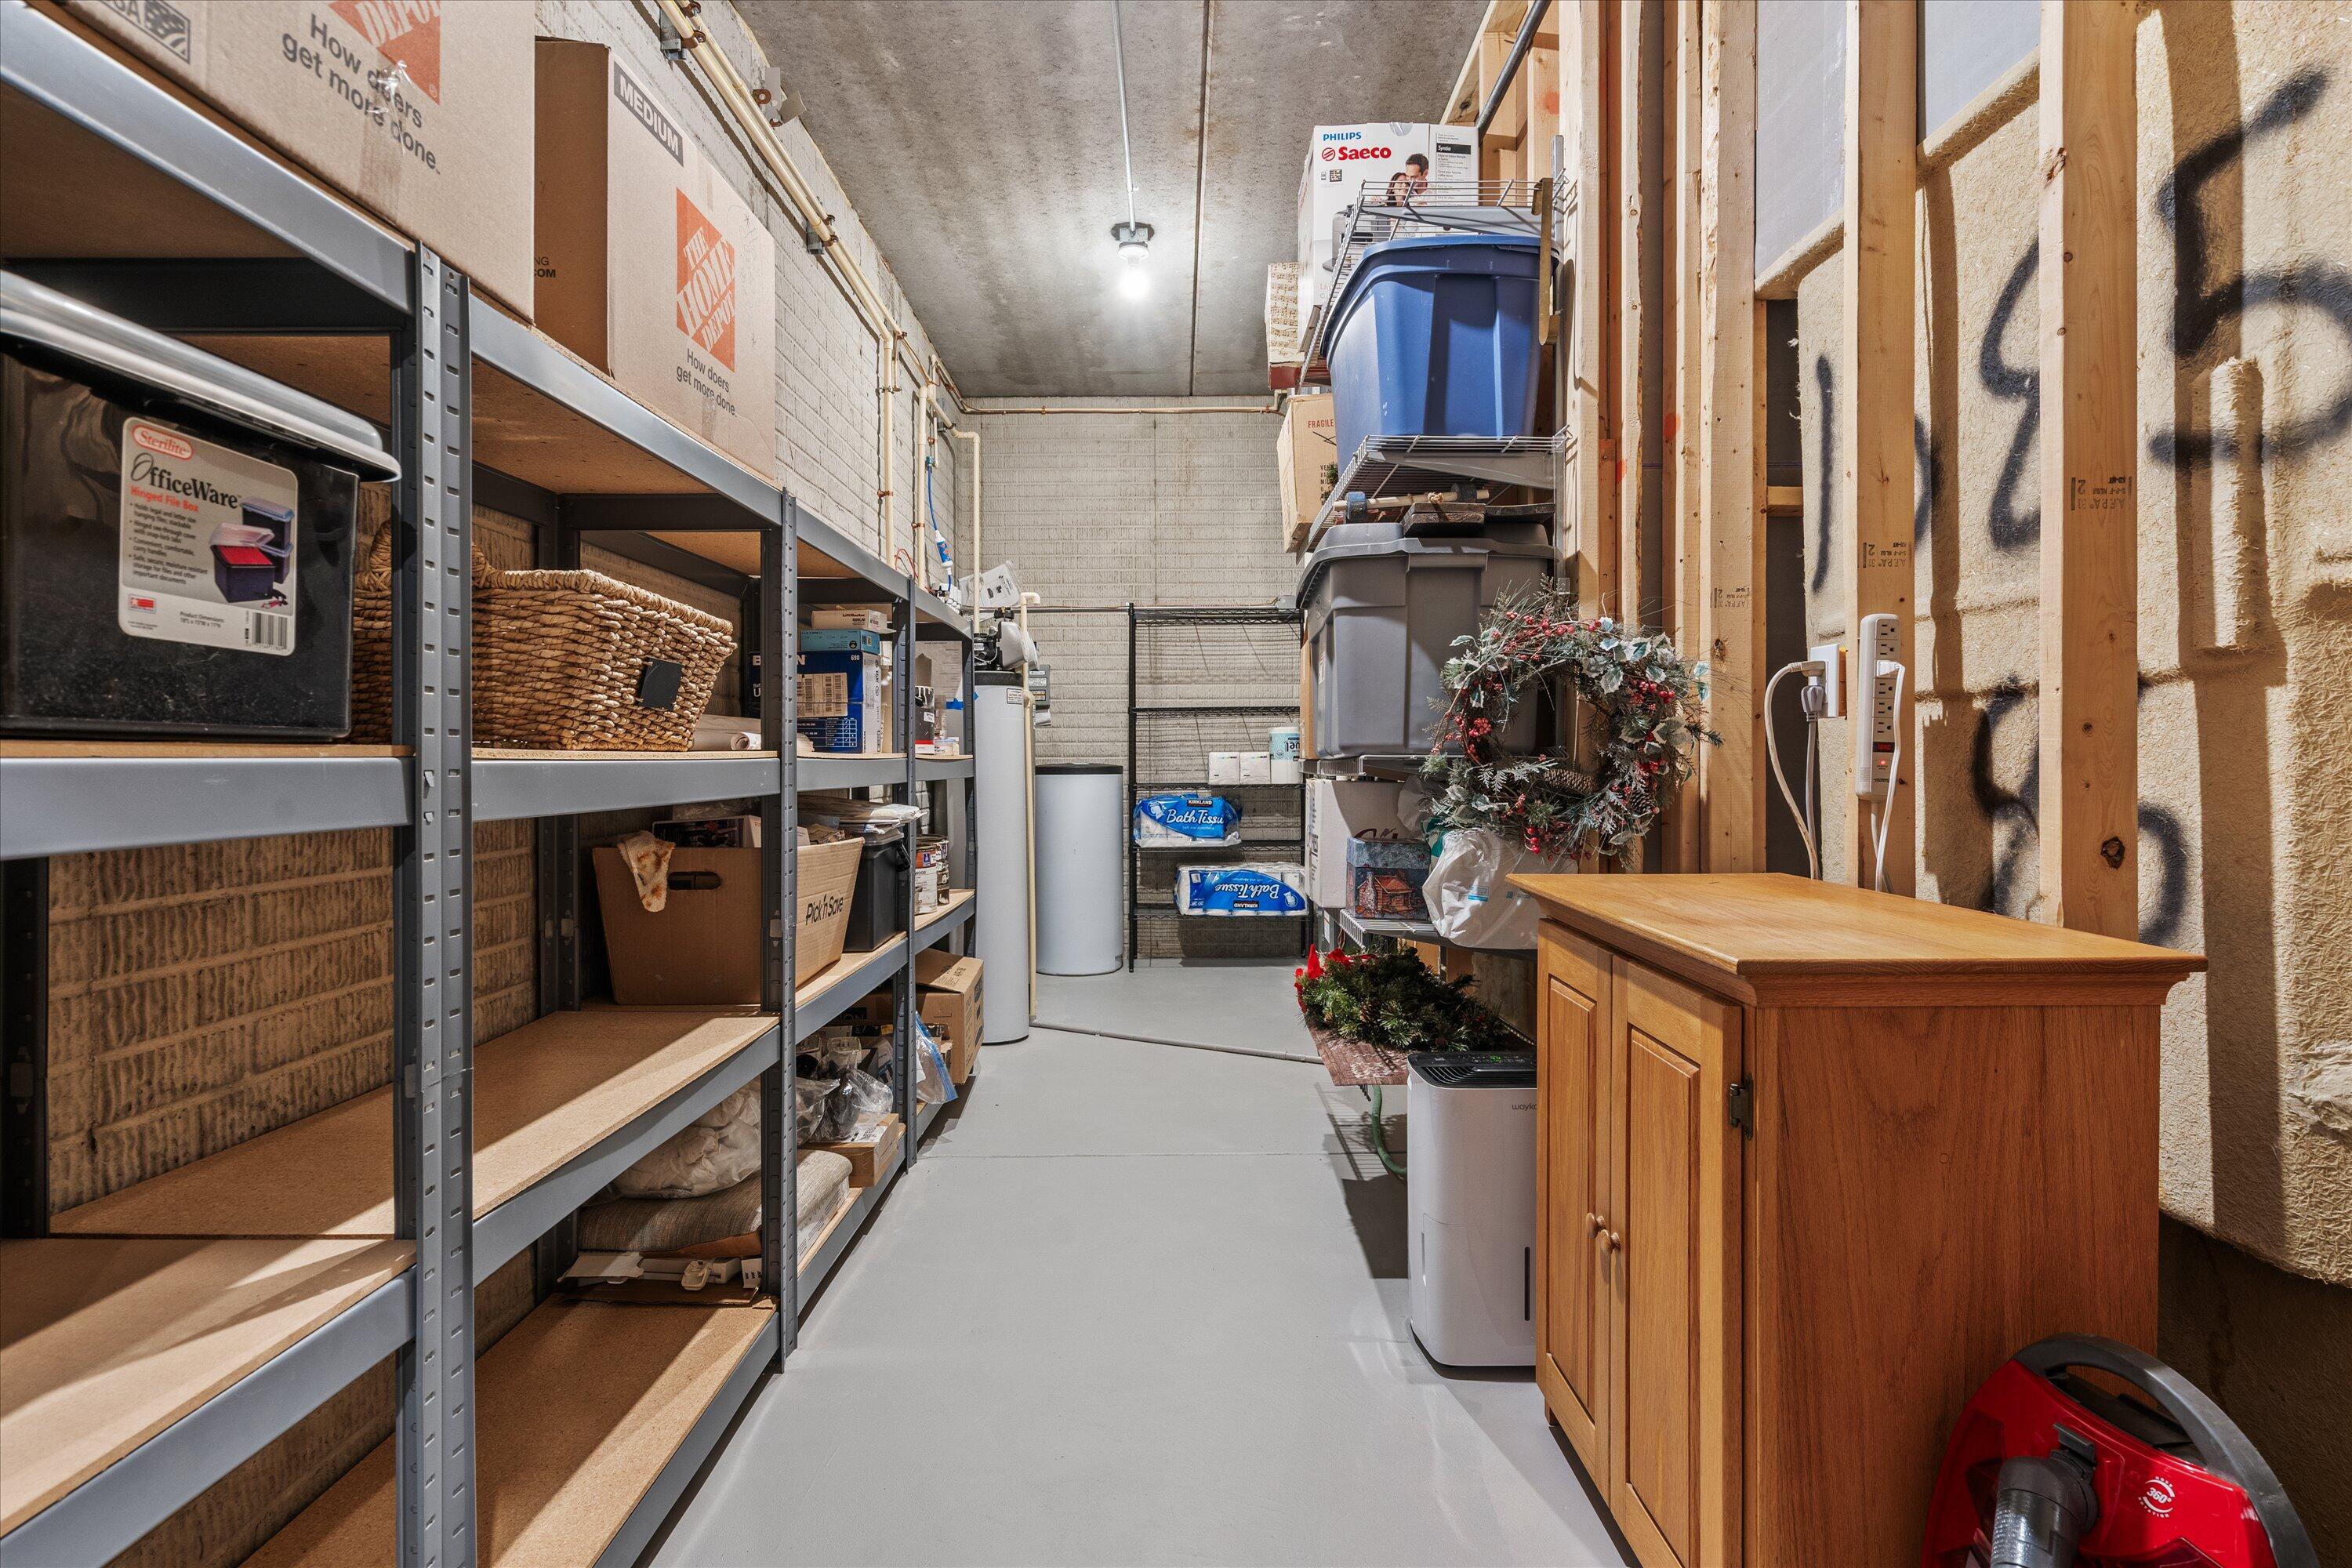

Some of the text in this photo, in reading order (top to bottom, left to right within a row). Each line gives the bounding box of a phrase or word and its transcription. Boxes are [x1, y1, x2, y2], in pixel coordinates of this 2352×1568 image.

[282, 33, 322, 78] get
[329, 68, 385, 127] more
[310, 13, 422, 129] How doers
[620, 74, 679, 156] MEDIUM
[1323, 132, 1362, 141] PHILIPS
[1338, 146, 1392, 161] Saeco
[683, 227, 709, 271] THE
[676, 236, 735, 336] HOME
[701, 290, 735, 353] DEPOT
[677, 365, 691, 385] get
[693, 377, 714, 401] more
[687, 348, 729, 393] How doers
[1308, 419, 1334, 428] FRAGILE
[141, 430, 187, 455] Sterilite
[131, 485, 198, 512] Hinged File Box
[2078, 480, 2085, 495] 2
[1868, 544, 1875, 556] 2
[1167, 809, 1198, 824] Bath
[1215, 883, 1279, 899] Bath Tissue
[806, 901, 822, 925] Pick
[828, 896, 844, 916] Save
